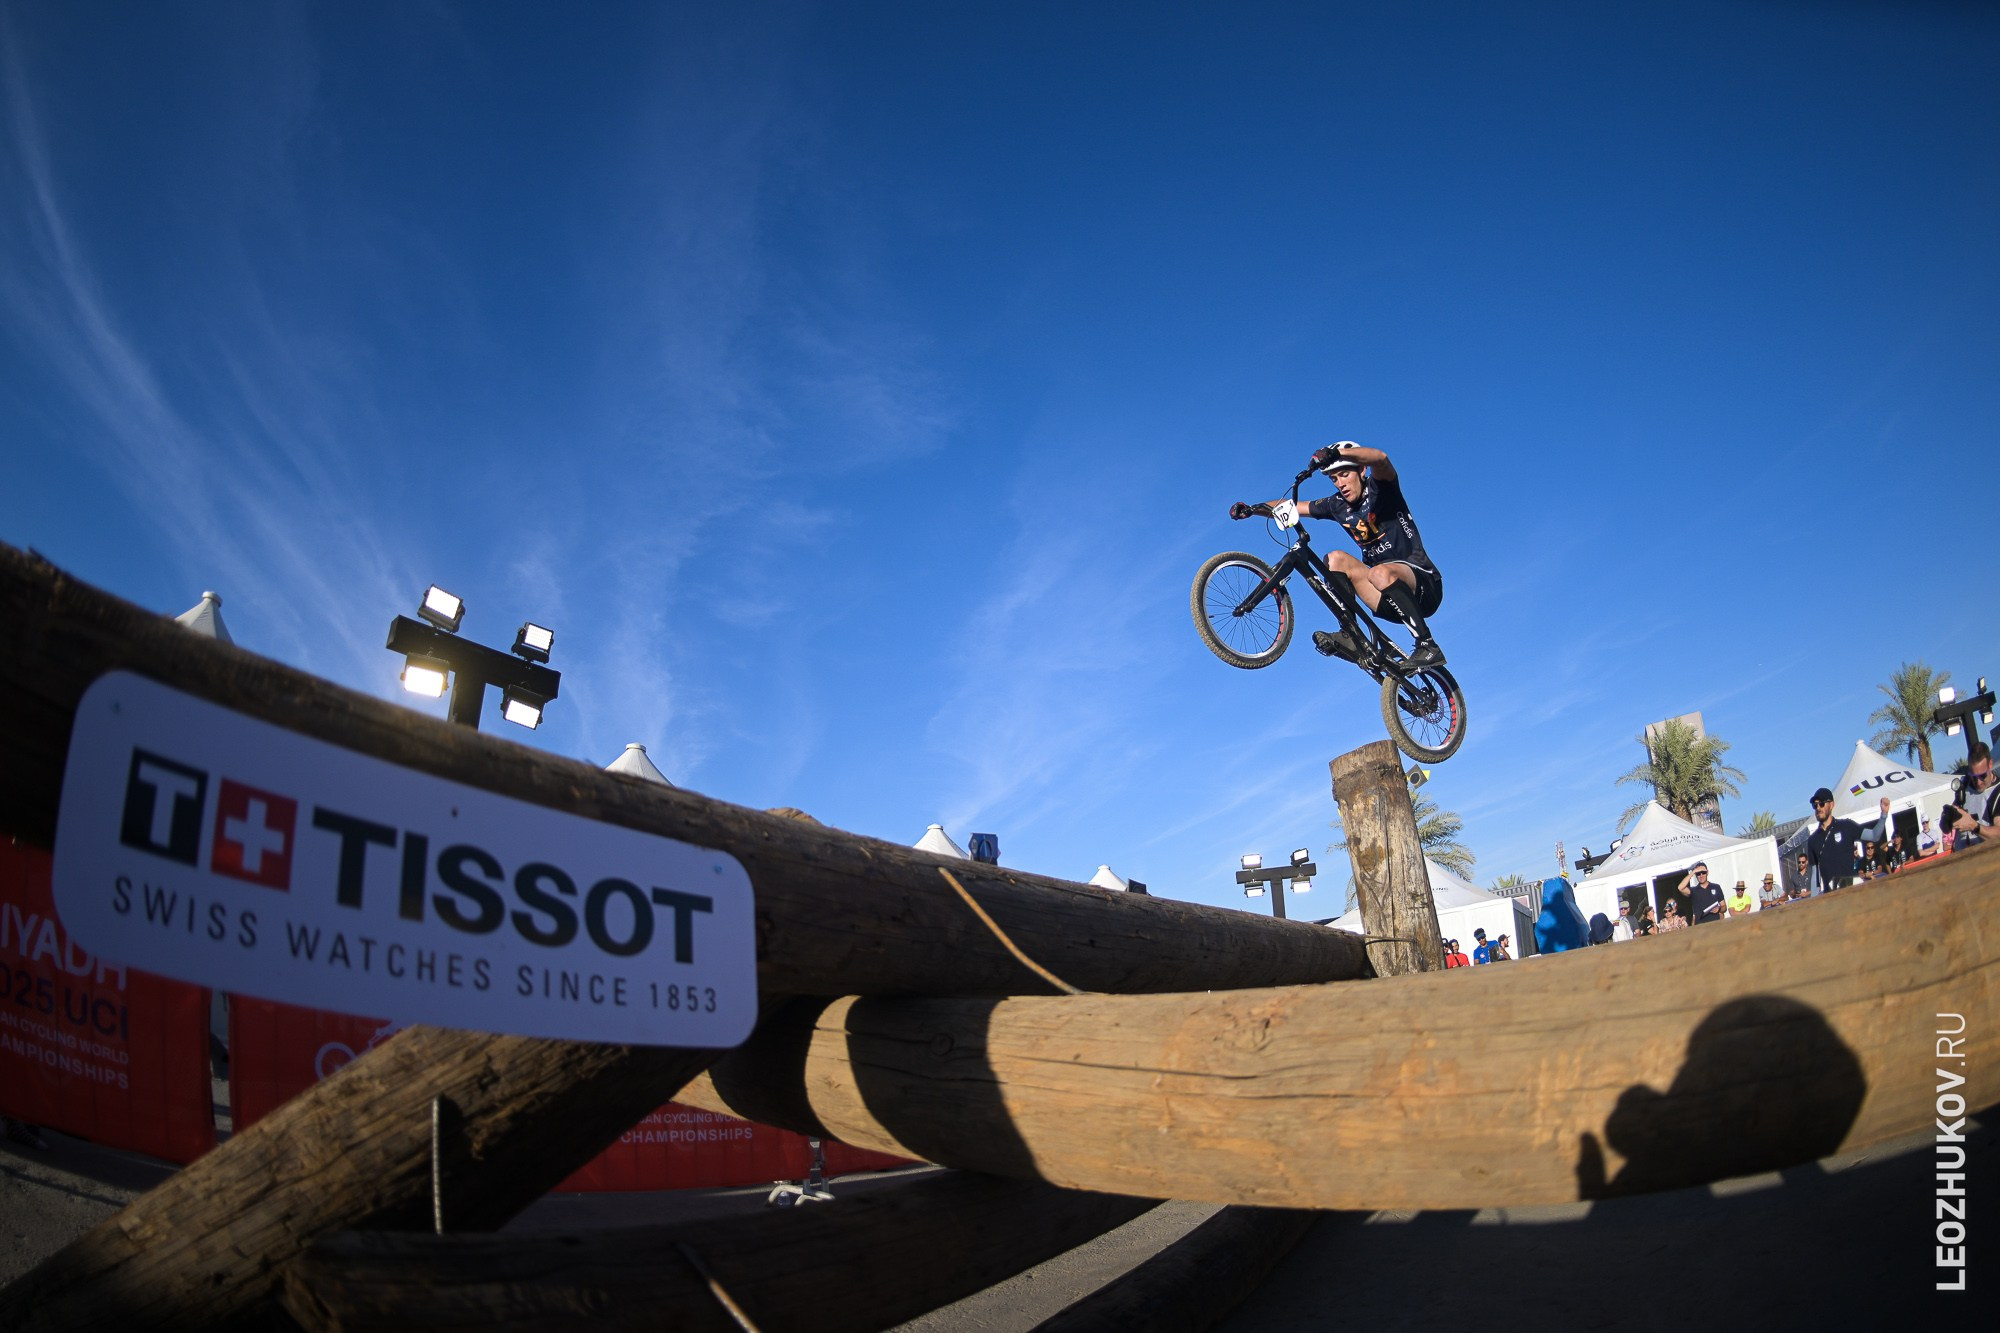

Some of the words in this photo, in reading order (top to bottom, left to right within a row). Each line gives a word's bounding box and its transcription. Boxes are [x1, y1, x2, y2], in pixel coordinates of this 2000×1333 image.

[1860, 770, 1915, 790] UCI
[311, 805, 715, 965] TISSOT
[112, 874, 258, 949] SWISS
[285, 920, 491, 992] WATCHES
[516, 964, 628, 1007] SINCE
[650, 982, 717, 1014] 1853
[64, 987, 129, 1041] UCI
[20, 1019, 77, 1049] CYCLING
[79, 1039, 129, 1065] WORLD
[620, 1127, 753, 1144] CHAMPIONSHIPS
[663, 1112, 713, 1124] CYCLING
